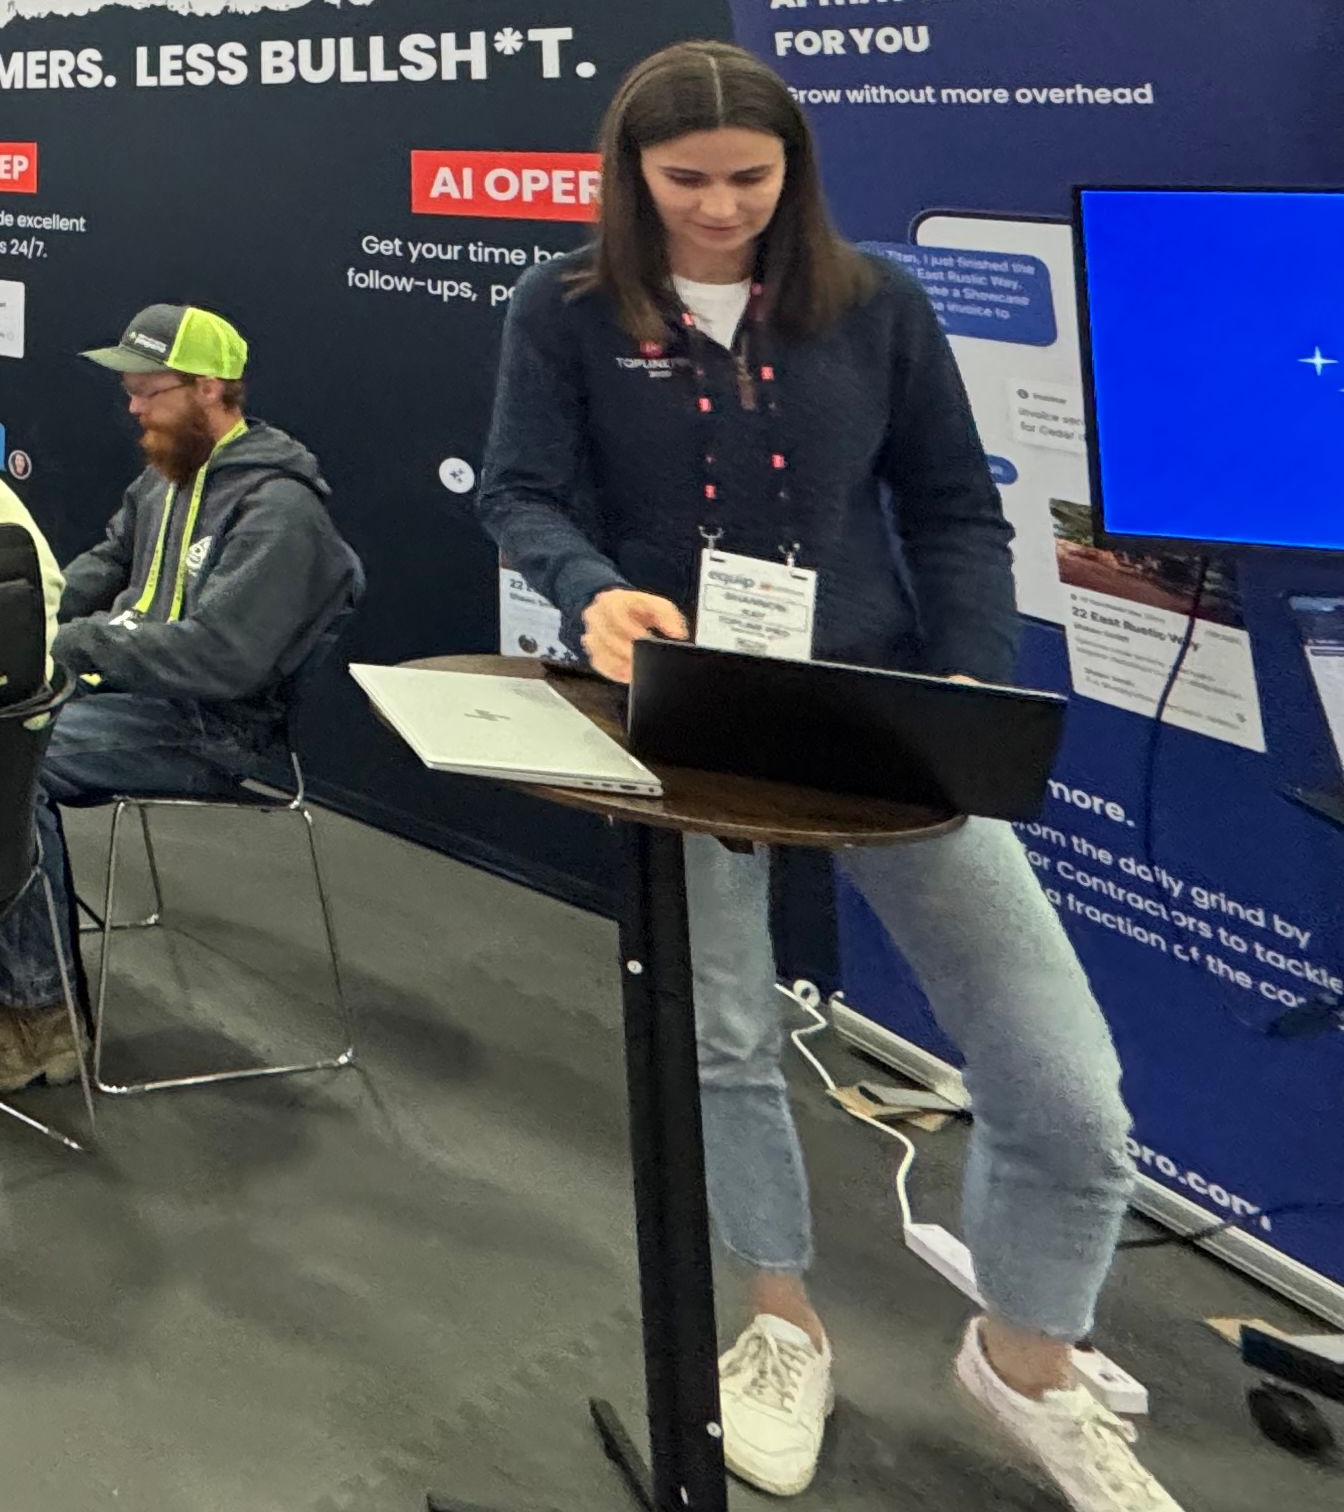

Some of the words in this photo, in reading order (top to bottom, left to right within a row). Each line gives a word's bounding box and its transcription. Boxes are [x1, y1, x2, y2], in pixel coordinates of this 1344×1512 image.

[774, 28, 845, 56] FOR
[848, 25, 931, 54] YOU
[135, 42, 249, 88] LESS
[845, 84, 936, 105] without
[941, 86, 1009, 104] more
[1015, 83, 1154, 105] overhead
[429, 166, 473, 200] AI
[484, 168, 601, 205] OPER
[17, 213, 87, 232] excellent
[10, 236, 48, 259] 24/7.
[361, 234, 403, 257] Get
[408, 240, 463, 263] your
[468, 241, 527, 265] time
[957, 256, 1009, 272] finished
[347, 267, 478, 303] follow-ups,
[1072, 605, 1088, 620] 22
[1090, 611, 1120, 627] East
[1123, 620, 1166, 641] Rustic
[1070, 835, 1113, 865] the
[1118, 856, 1183, 898] daily
[1190, 886, 1265, 929] grind
[1272, 914, 1311, 950] by
[1057, 859, 1214, 939] Contractors
[1216, 925, 1249, 954] to
[1253, 941, 1343, 995] tackle
[1066, 892, 1167, 952] fraction
[1206, 953, 1253, 990] the
